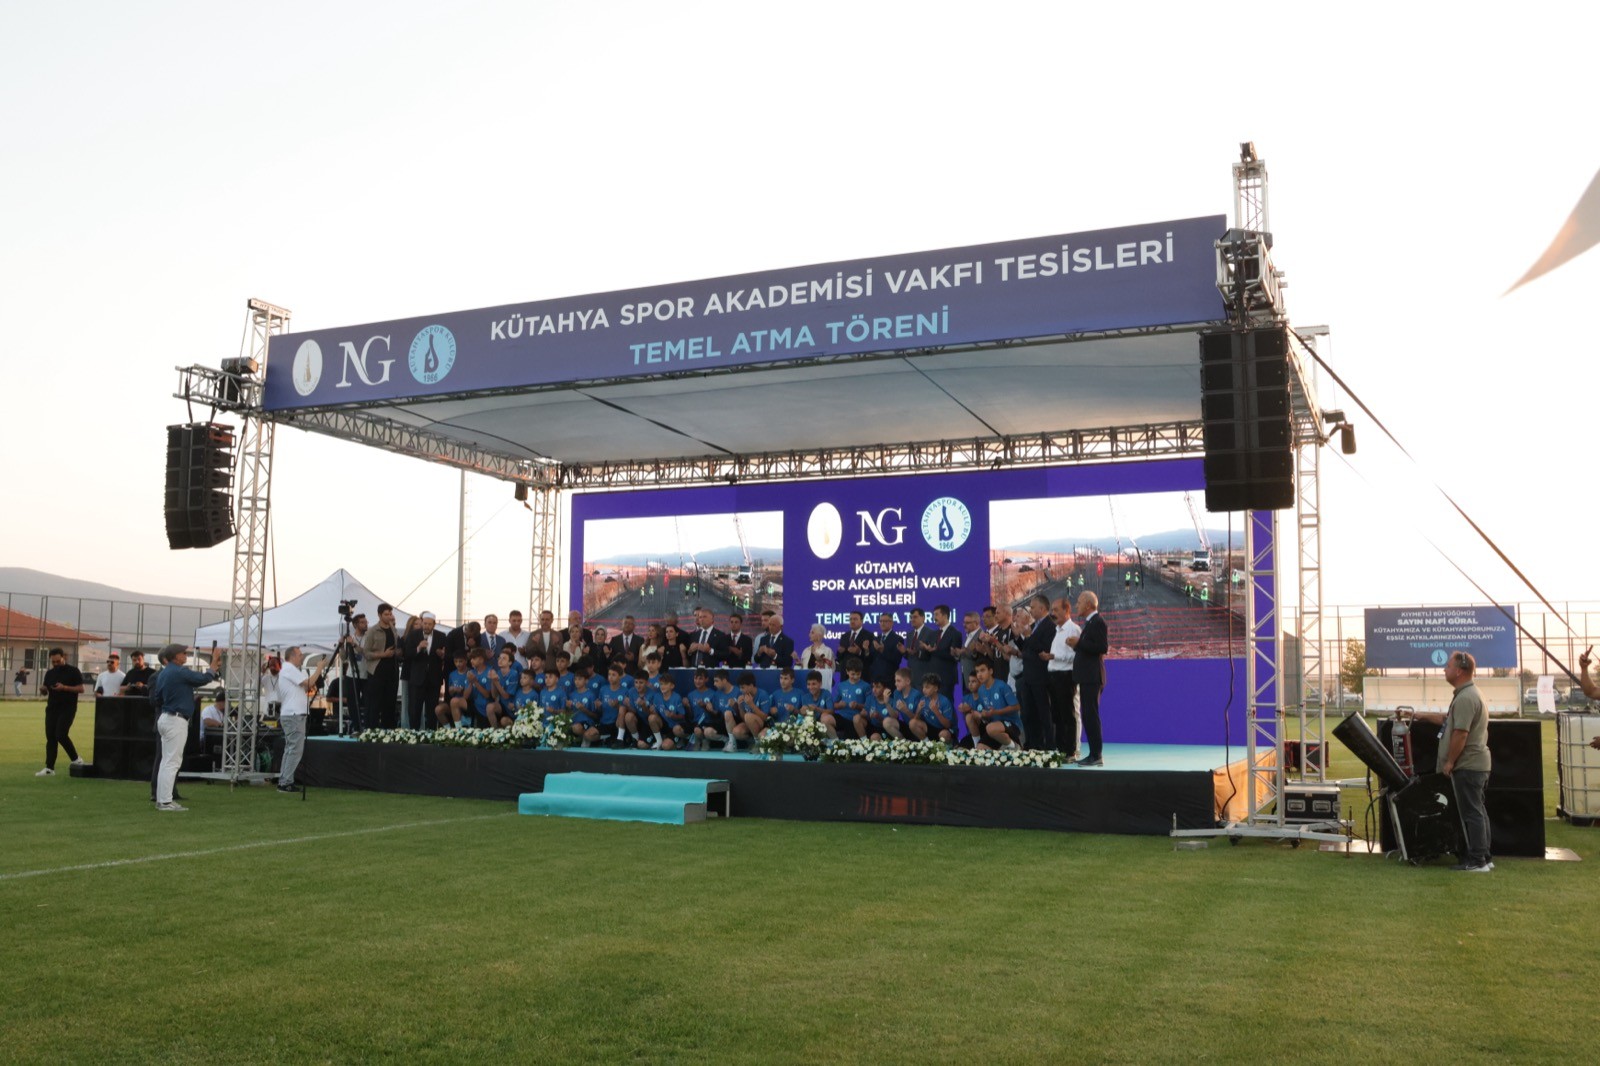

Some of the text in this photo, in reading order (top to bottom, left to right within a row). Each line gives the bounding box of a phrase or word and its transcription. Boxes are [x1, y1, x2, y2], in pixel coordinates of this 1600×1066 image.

[490, 231, 1174, 341] KÜTAHYA SPOR AKADEMİSİ VAKFI TESİSLERİ
[629, 305, 949, 366] TEMEL ATMA TÖRENİ
[336, 334, 396, 388] NG
[424, 373, 438, 383] 1966
[856, 507, 908, 546] NG
[855, 561, 915, 575] KÜTAHYA
[812, 575, 960, 591] SPOR AKADEMİSİ VAKFI
[854, 591, 916, 606] TESİSLERİ
[816, 612, 851, 624] TEME
[862, 612, 900, 624] ATA
